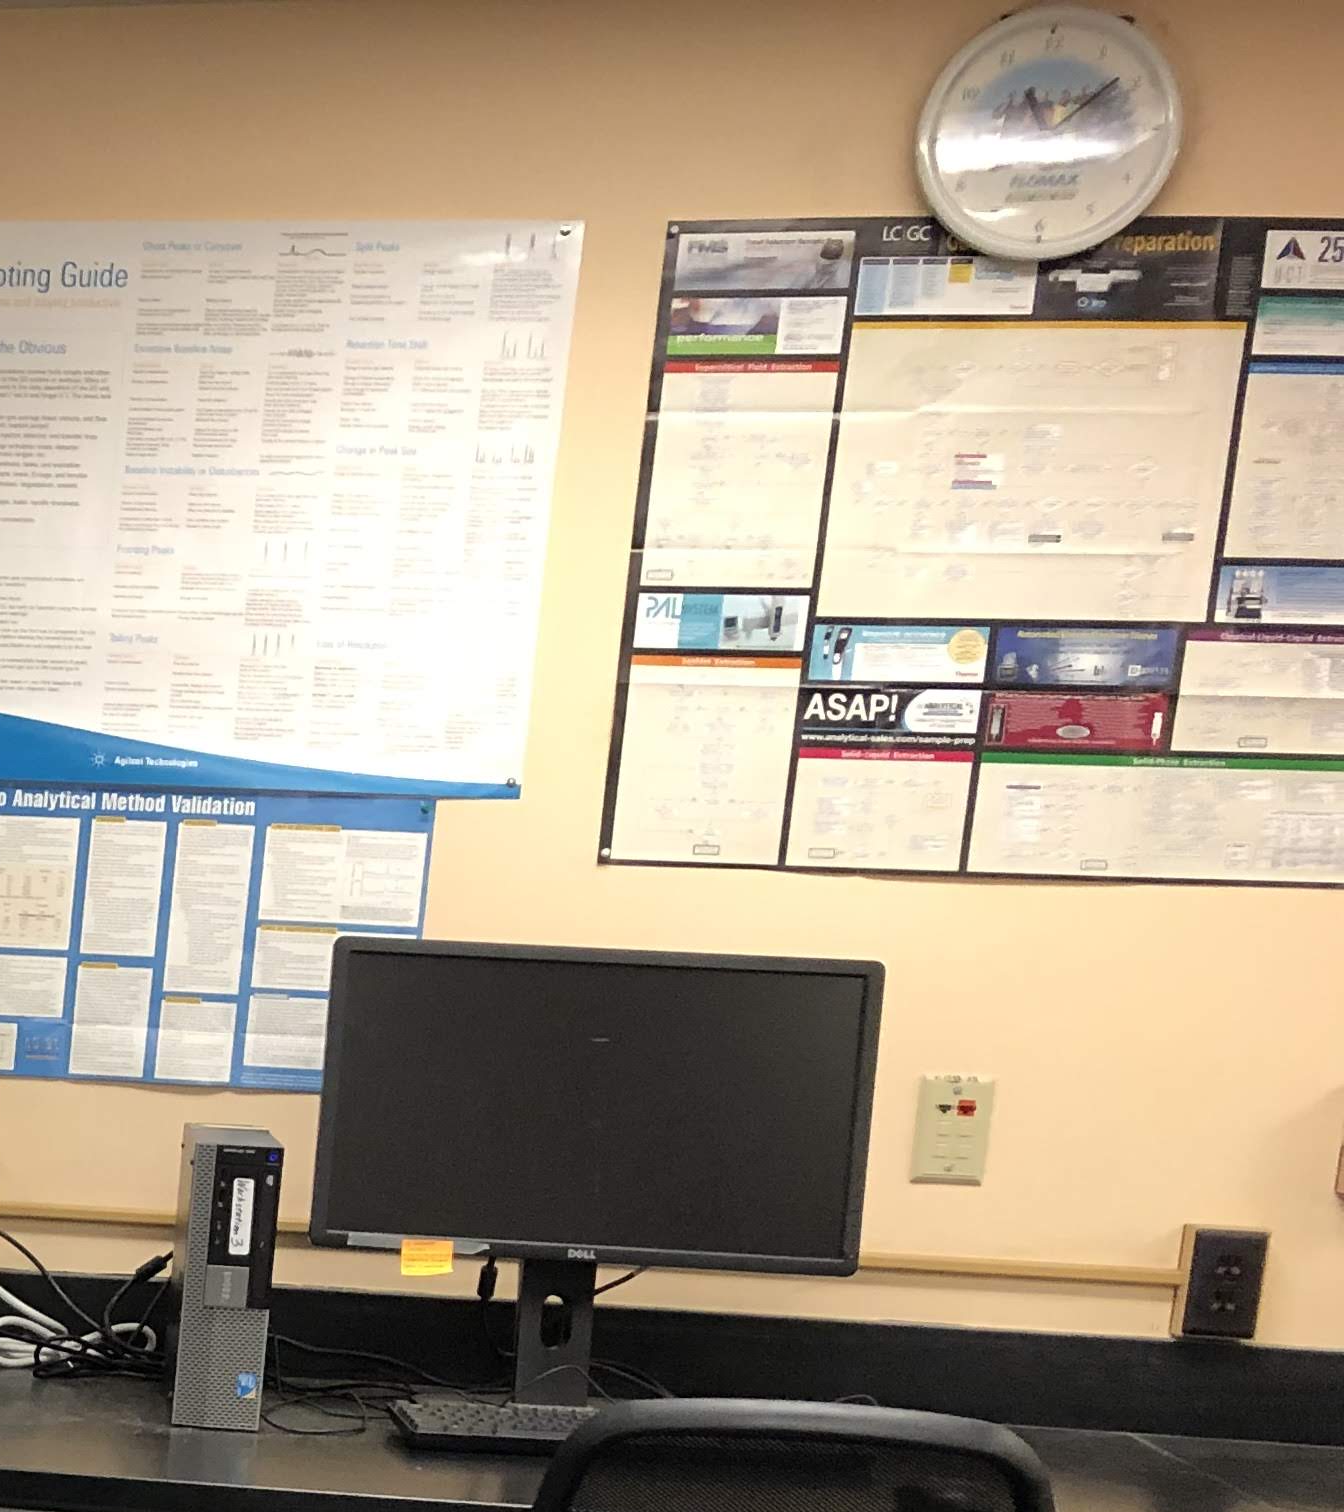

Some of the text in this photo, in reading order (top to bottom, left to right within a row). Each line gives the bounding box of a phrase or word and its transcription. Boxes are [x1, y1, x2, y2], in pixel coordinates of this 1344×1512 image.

[60, 262, 129, 289] Guide
[18, 340, 67, 355] Obvious
[803, 693, 899, 722] ASAP!
[114, 756, 199, 768] Agilent Technologies
[12, 789, 96, 811] Analytical
[101, 793, 164, 812] Method
[171, 795, 256, 816] Validation
[567, 1248, 597, 1260] DELL
